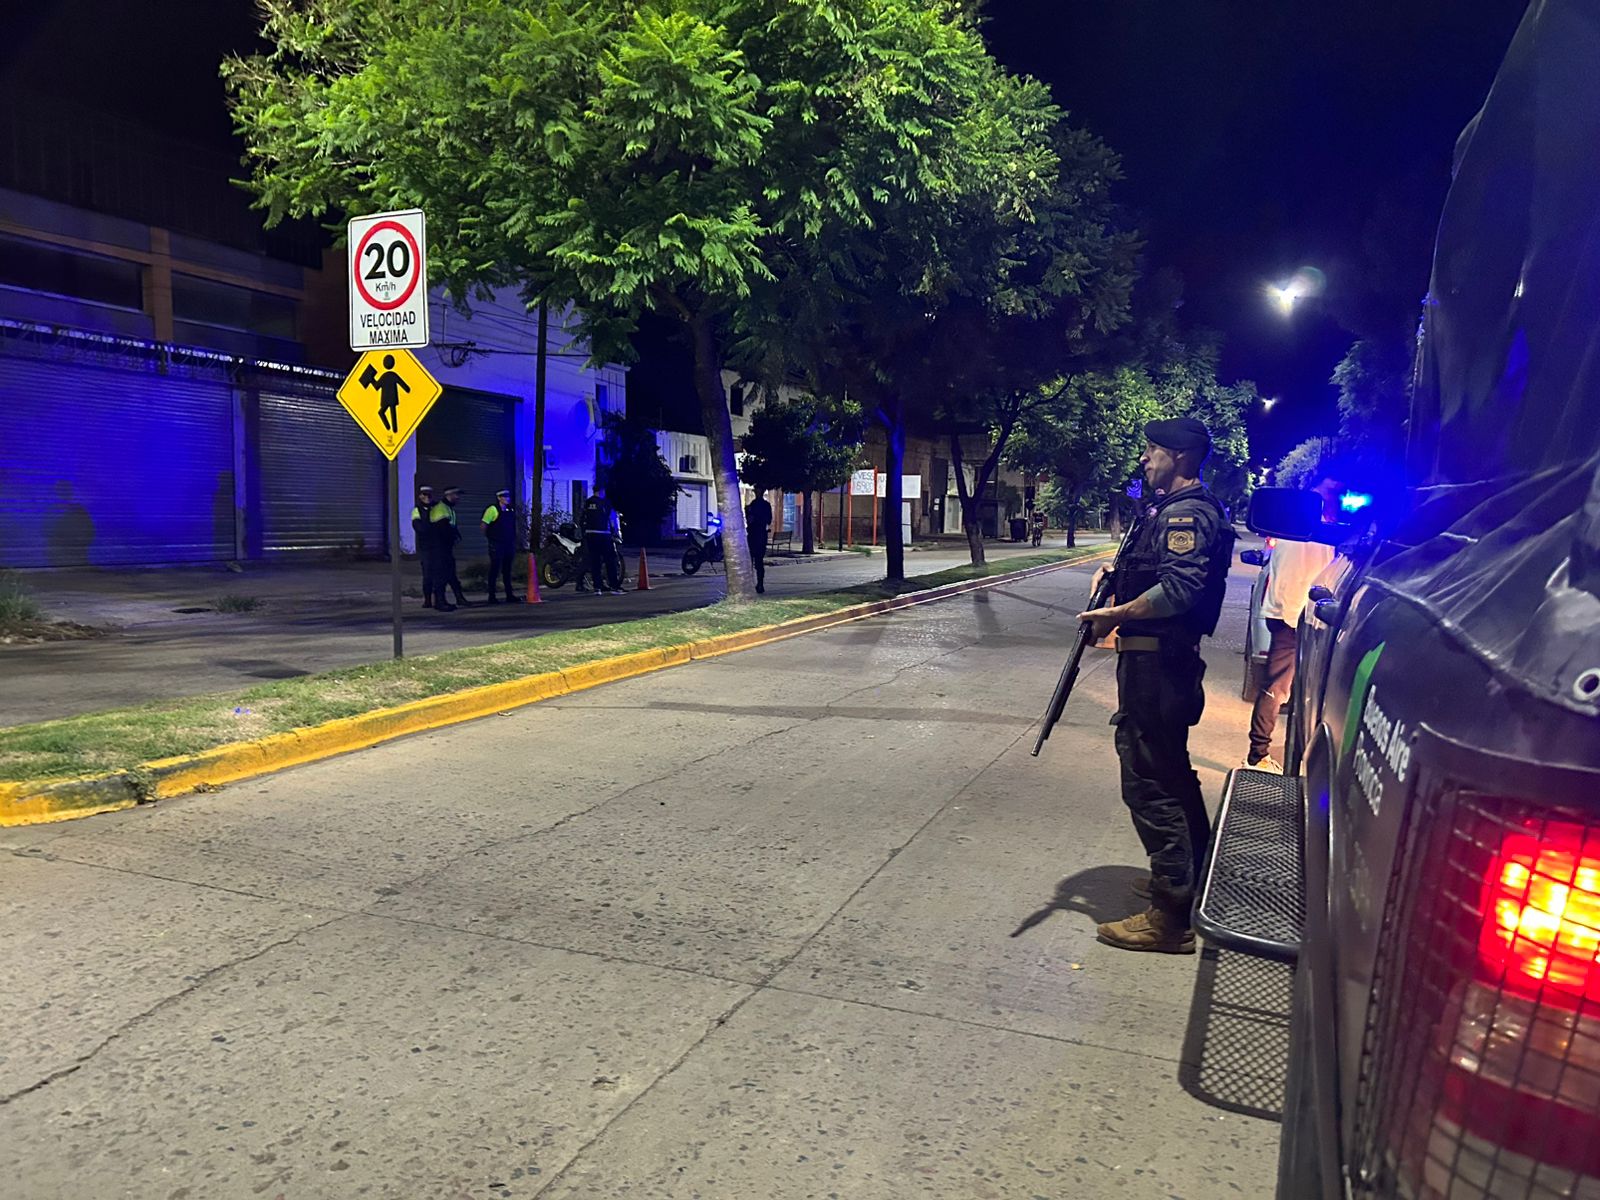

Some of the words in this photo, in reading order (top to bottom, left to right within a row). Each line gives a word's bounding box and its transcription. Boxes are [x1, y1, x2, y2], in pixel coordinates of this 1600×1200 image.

[364, 240, 410, 280] 20
[375, 281, 396, 292] Km/h
[360, 311, 416, 328] VELOCIDAD
